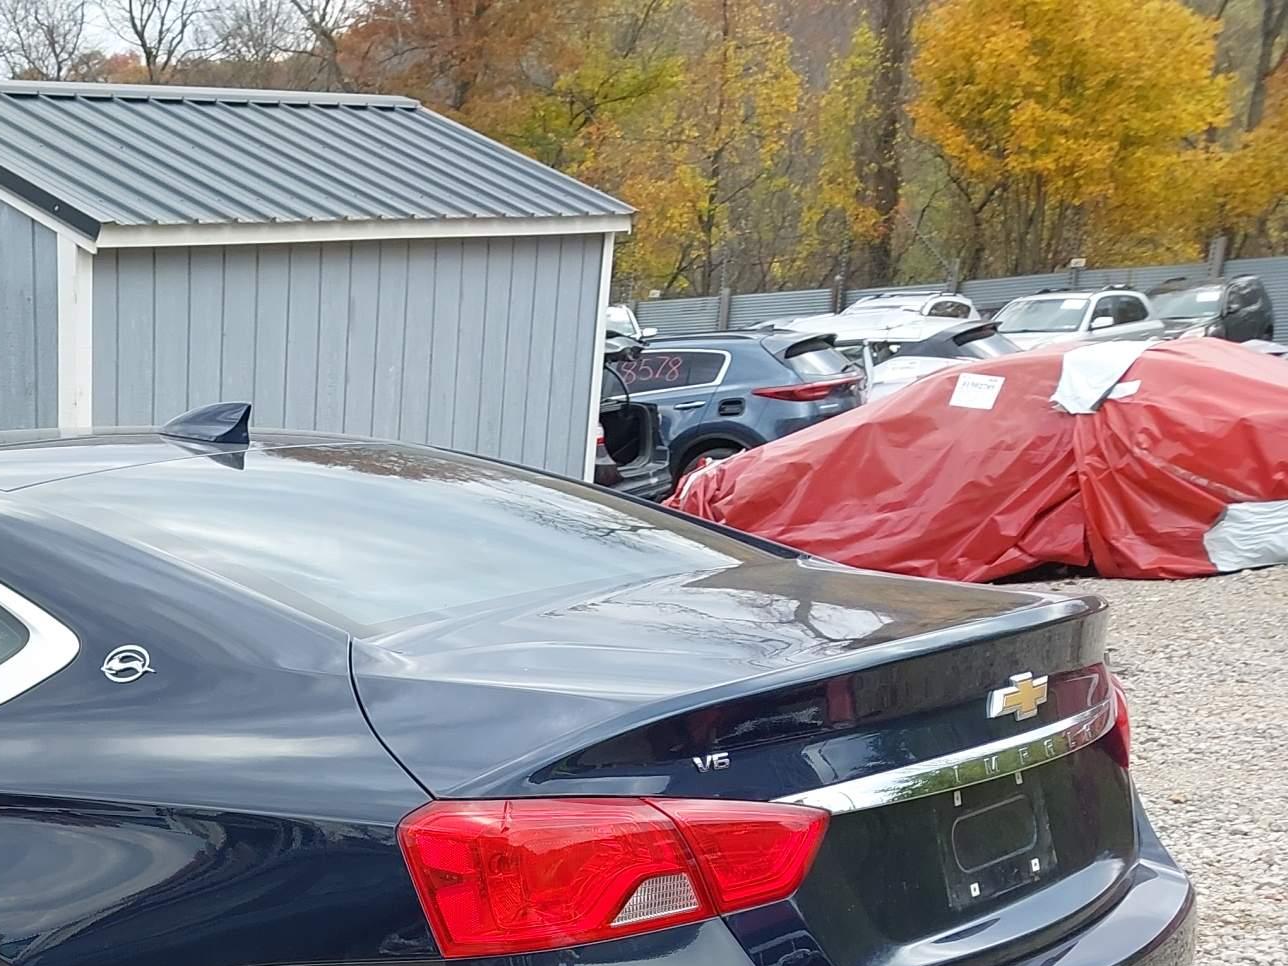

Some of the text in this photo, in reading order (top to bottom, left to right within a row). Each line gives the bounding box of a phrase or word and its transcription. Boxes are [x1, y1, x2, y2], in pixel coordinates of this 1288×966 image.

[621, 356, 682, 385] 8578
[692, 752, 730, 773] V6
[952, 722, 1093, 784] IMPALA
